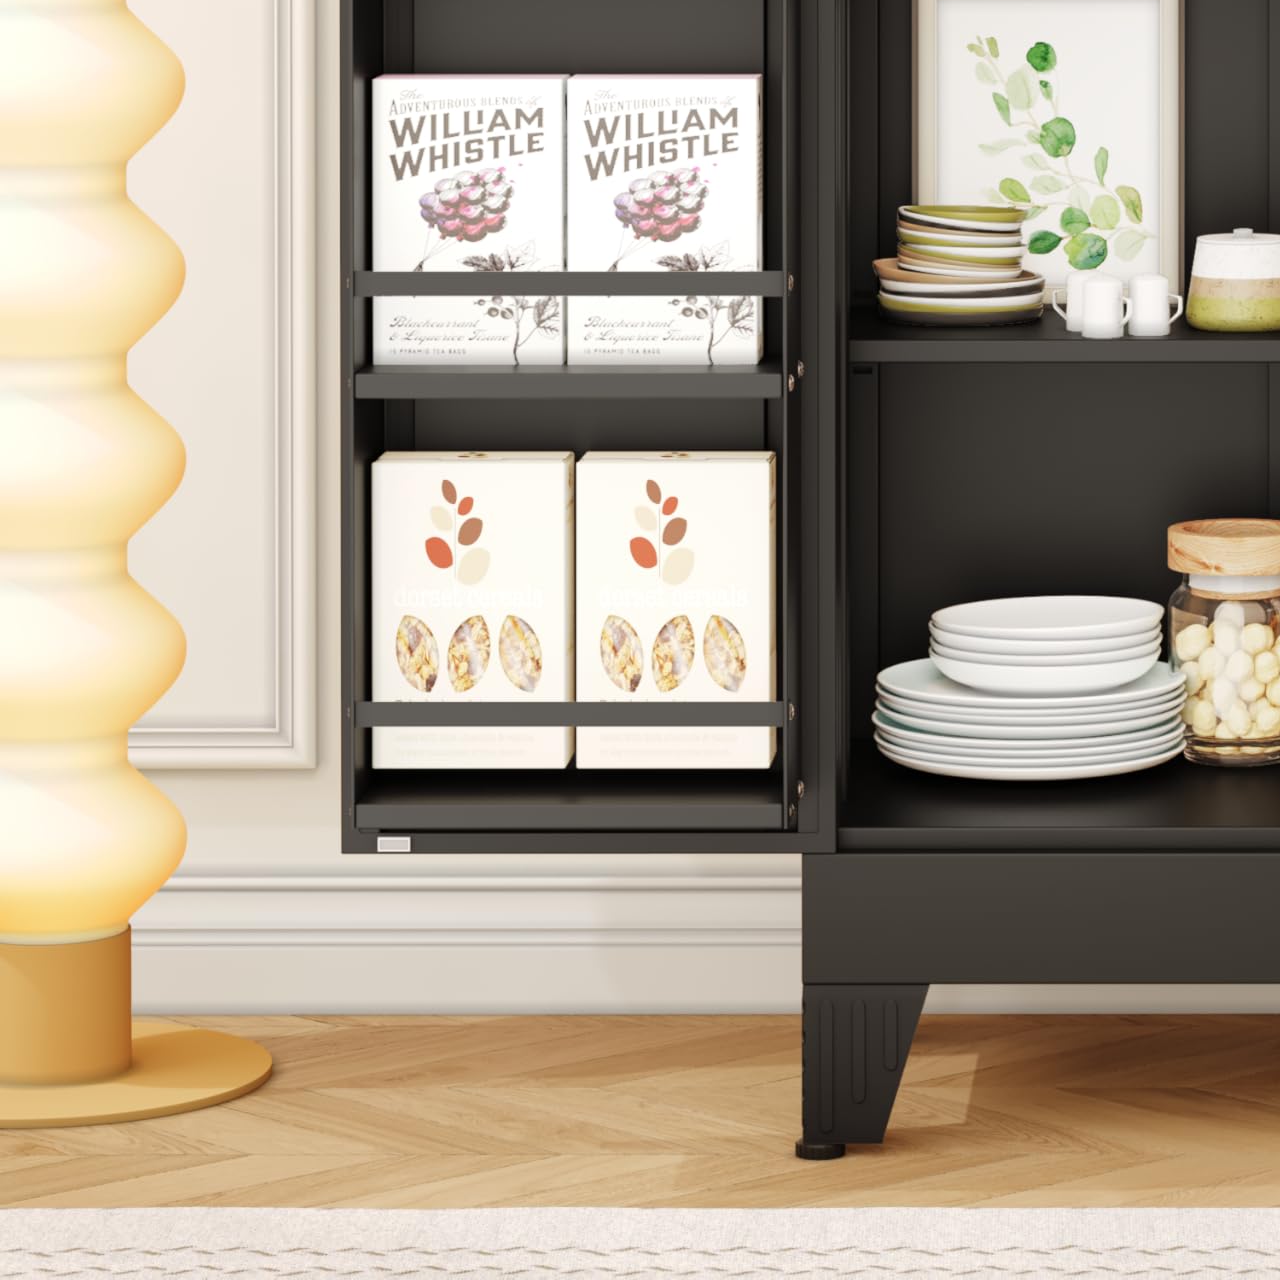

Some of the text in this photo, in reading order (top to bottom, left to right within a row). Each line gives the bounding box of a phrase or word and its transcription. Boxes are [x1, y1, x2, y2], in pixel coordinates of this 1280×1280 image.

[390, 107, 544, 148] WILLIAM
[584, 107, 738, 148] WILLIAM
[390, 132, 544, 182] WHISTLE
[584, 132, 738, 182] WHISTLE
